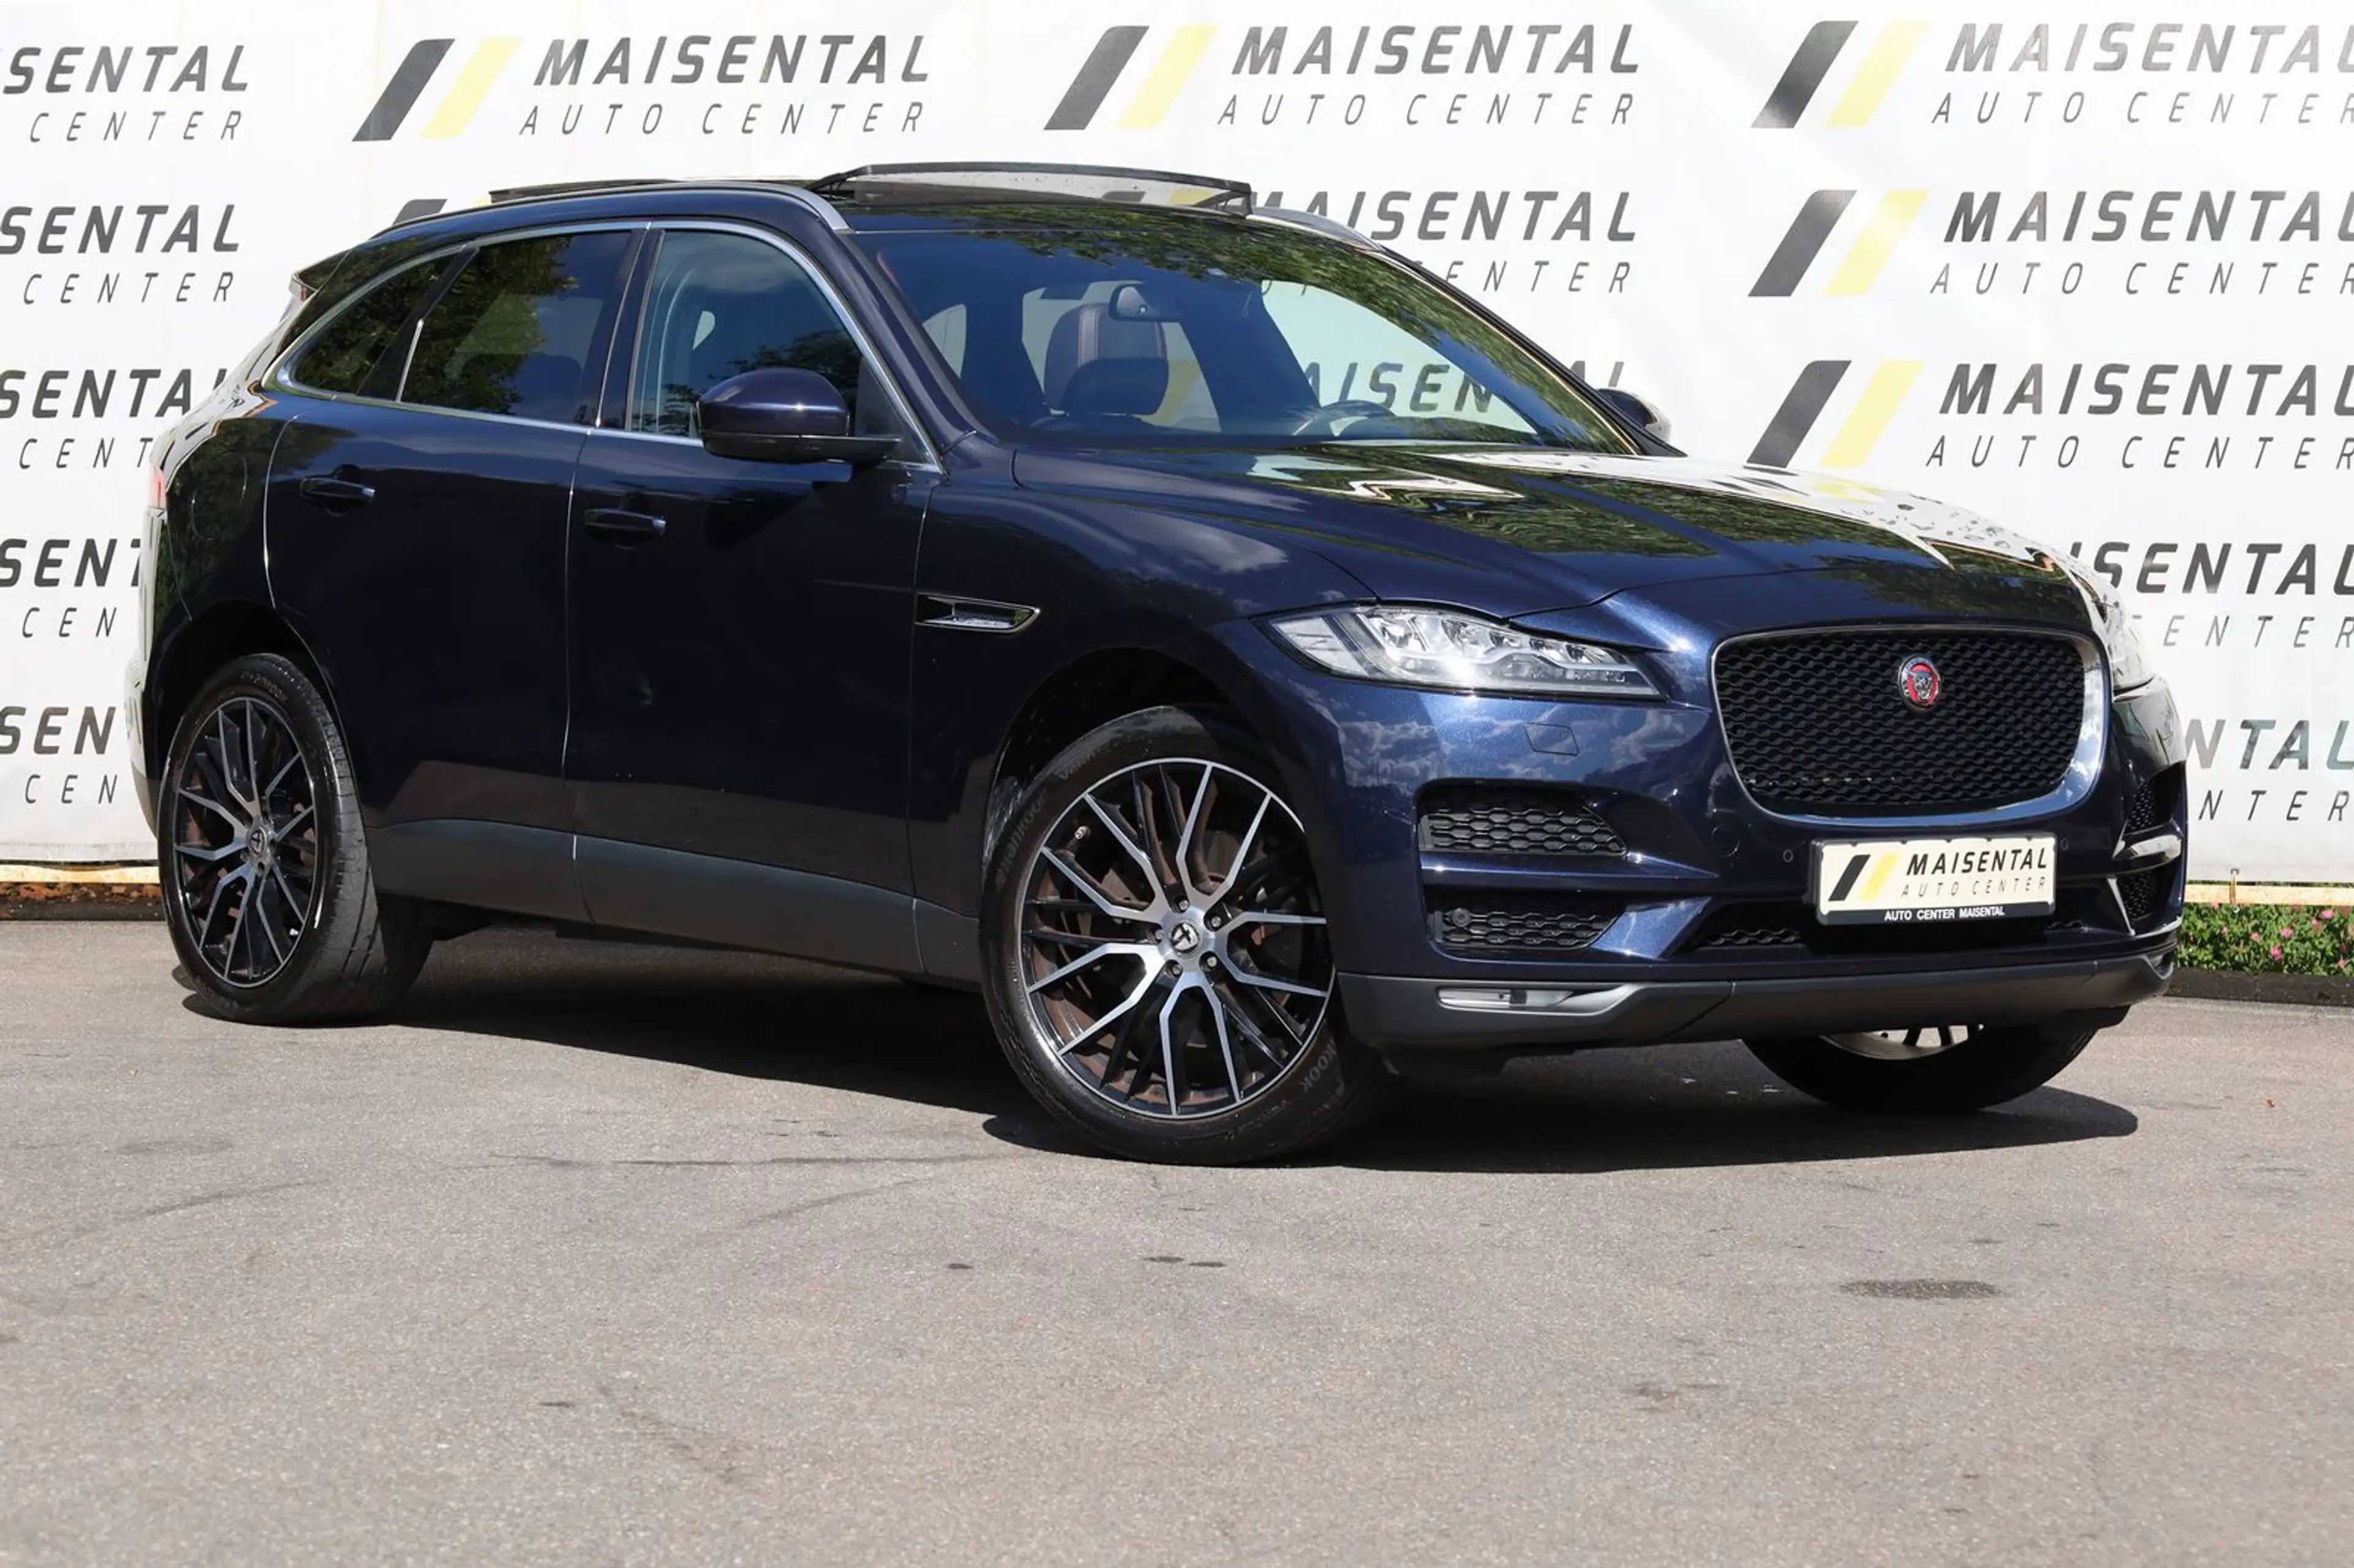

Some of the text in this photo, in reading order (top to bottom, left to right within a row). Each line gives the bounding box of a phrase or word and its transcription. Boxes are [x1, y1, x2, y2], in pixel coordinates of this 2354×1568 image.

[534, 36, 928, 85] MAISENTAL
[1232, 25, 1638, 75] MAISENTAL
[1945, 22, 2354, 74] MAISENTAL
[3, 45, 247, 94] SENTAL
[519, 102, 923, 135] AUTO CENTER
[1217, 93, 1632, 125] AUTO CENTER
[1932, 91, 2354, 124] AUTO CENTER
[30, 110, 241, 143] CENTER
[0, 205, 238, 254] SENTAL
[1943, 191, 2354, 243] MAISENTAL
[24, 272, 233, 305] CENTER
[1413, 261, 1630, 294] ENTER
[1930, 262, 2354, 295] AUTO CENTER
[0, 369, 227, 419] SENTA
[1939, 363, 2354, 417] MAISENTAL
[1925, 435, 2354, 470] AUTO CENTER
[22, 607, 116, 638] CEN
[2132, 615, 2354, 649] ENTER
[0, 706, 116, 755] SEN
[25, 774, 117, 804] CEN
[2198, 790, 2349, 822] NTER
[1906, 848, 2047, 875] MAISENTAL
[1901, 877, 2046, 898] AUTO CENTER
[1884, 905, 2005, 921] AUTO CENTER MAISENTAL
